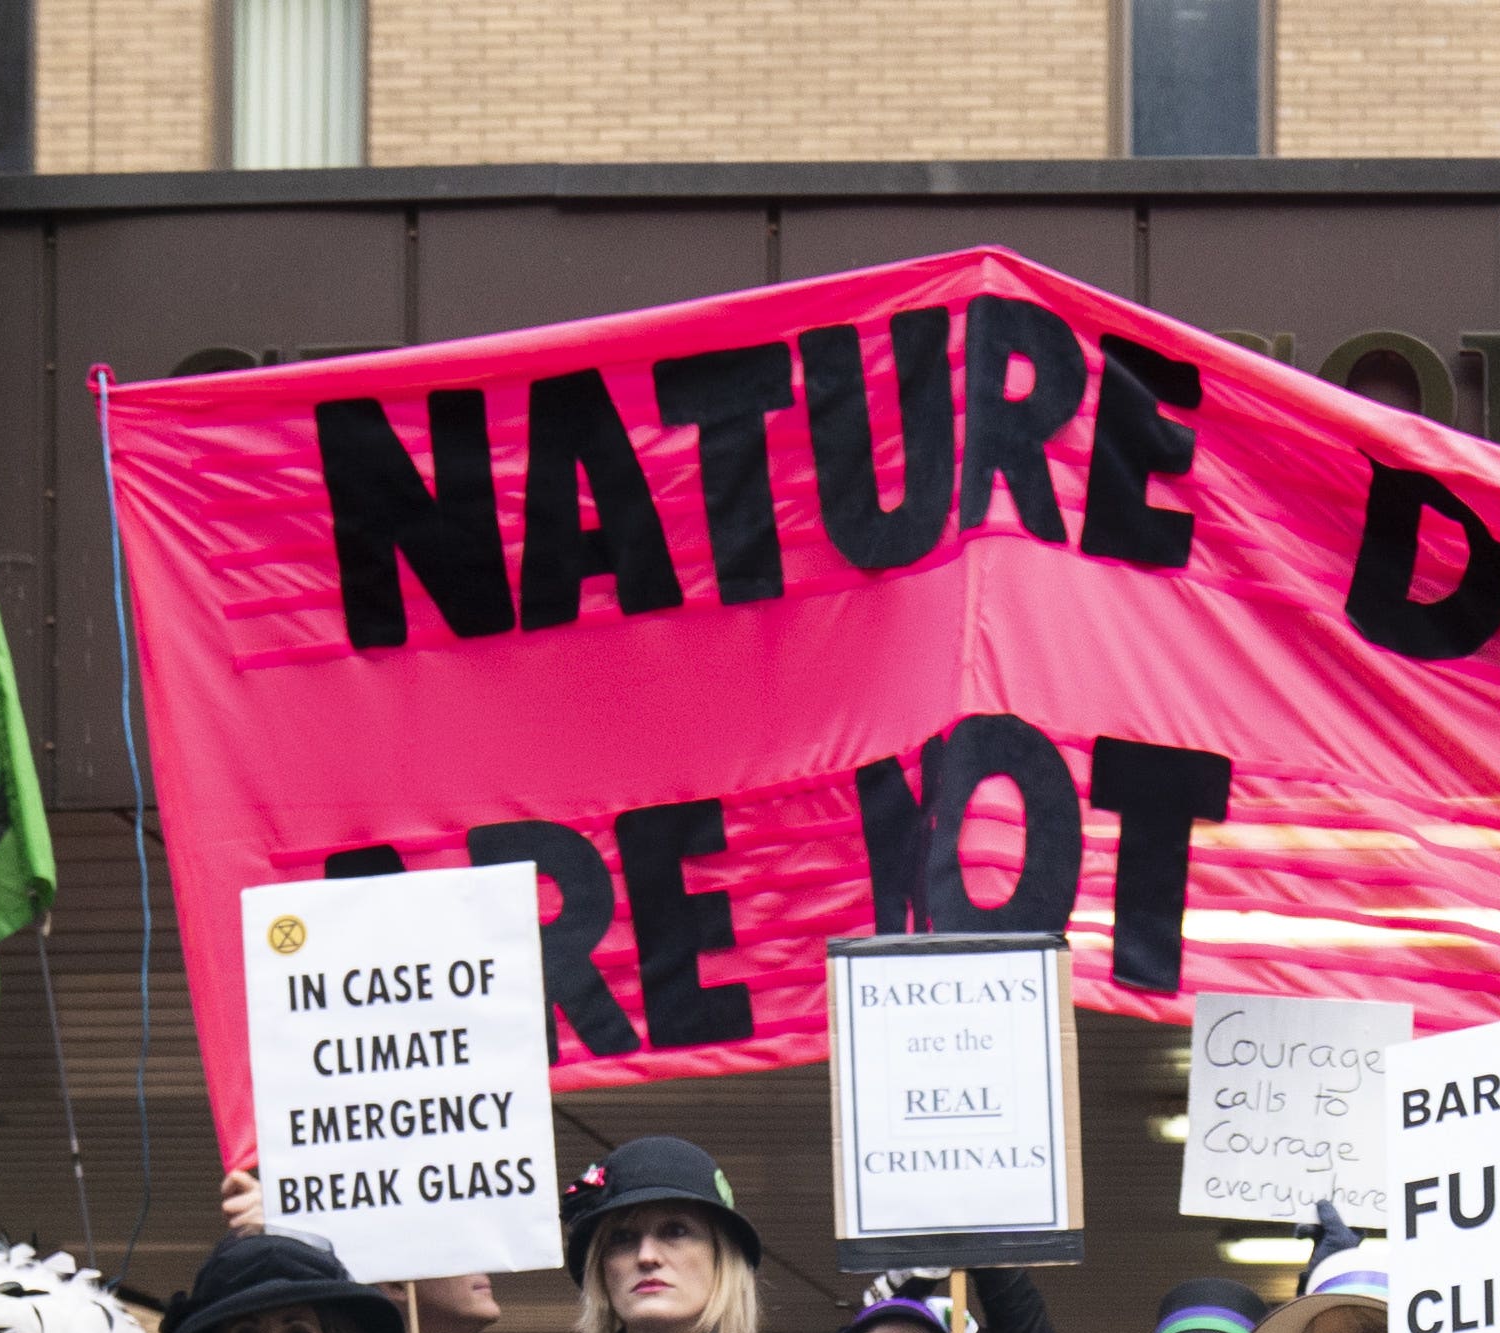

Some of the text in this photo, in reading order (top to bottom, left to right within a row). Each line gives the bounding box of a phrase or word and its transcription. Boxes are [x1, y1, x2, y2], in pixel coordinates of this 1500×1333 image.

[315, 291, 1204, 650] NATURE
[324, 797, 754, 1068] RE
[288, 958, 496, 1012] IN CASE OF
[860, 978, 1037, 1008] BARCLAYS
[313, 1028, 470, 1077] CLIMATE
[907, 1029, 993, 1053] are the
[1205, 1010, 1385, 1093] Courage
[290, 1091, 514, 1147] EMERGENCY
[905, 1087, 1002, 1119] REAL
[1215, 1080, 1349, 1116] calls to
[864, 1145, 1046, 1175] CRIMINALS
[1203, 1120, 1360, 1173] Courage
[279, 1157, 536, 1215] BREAK GLASS
[1205, 1174, 1388, 1217] everywhere
